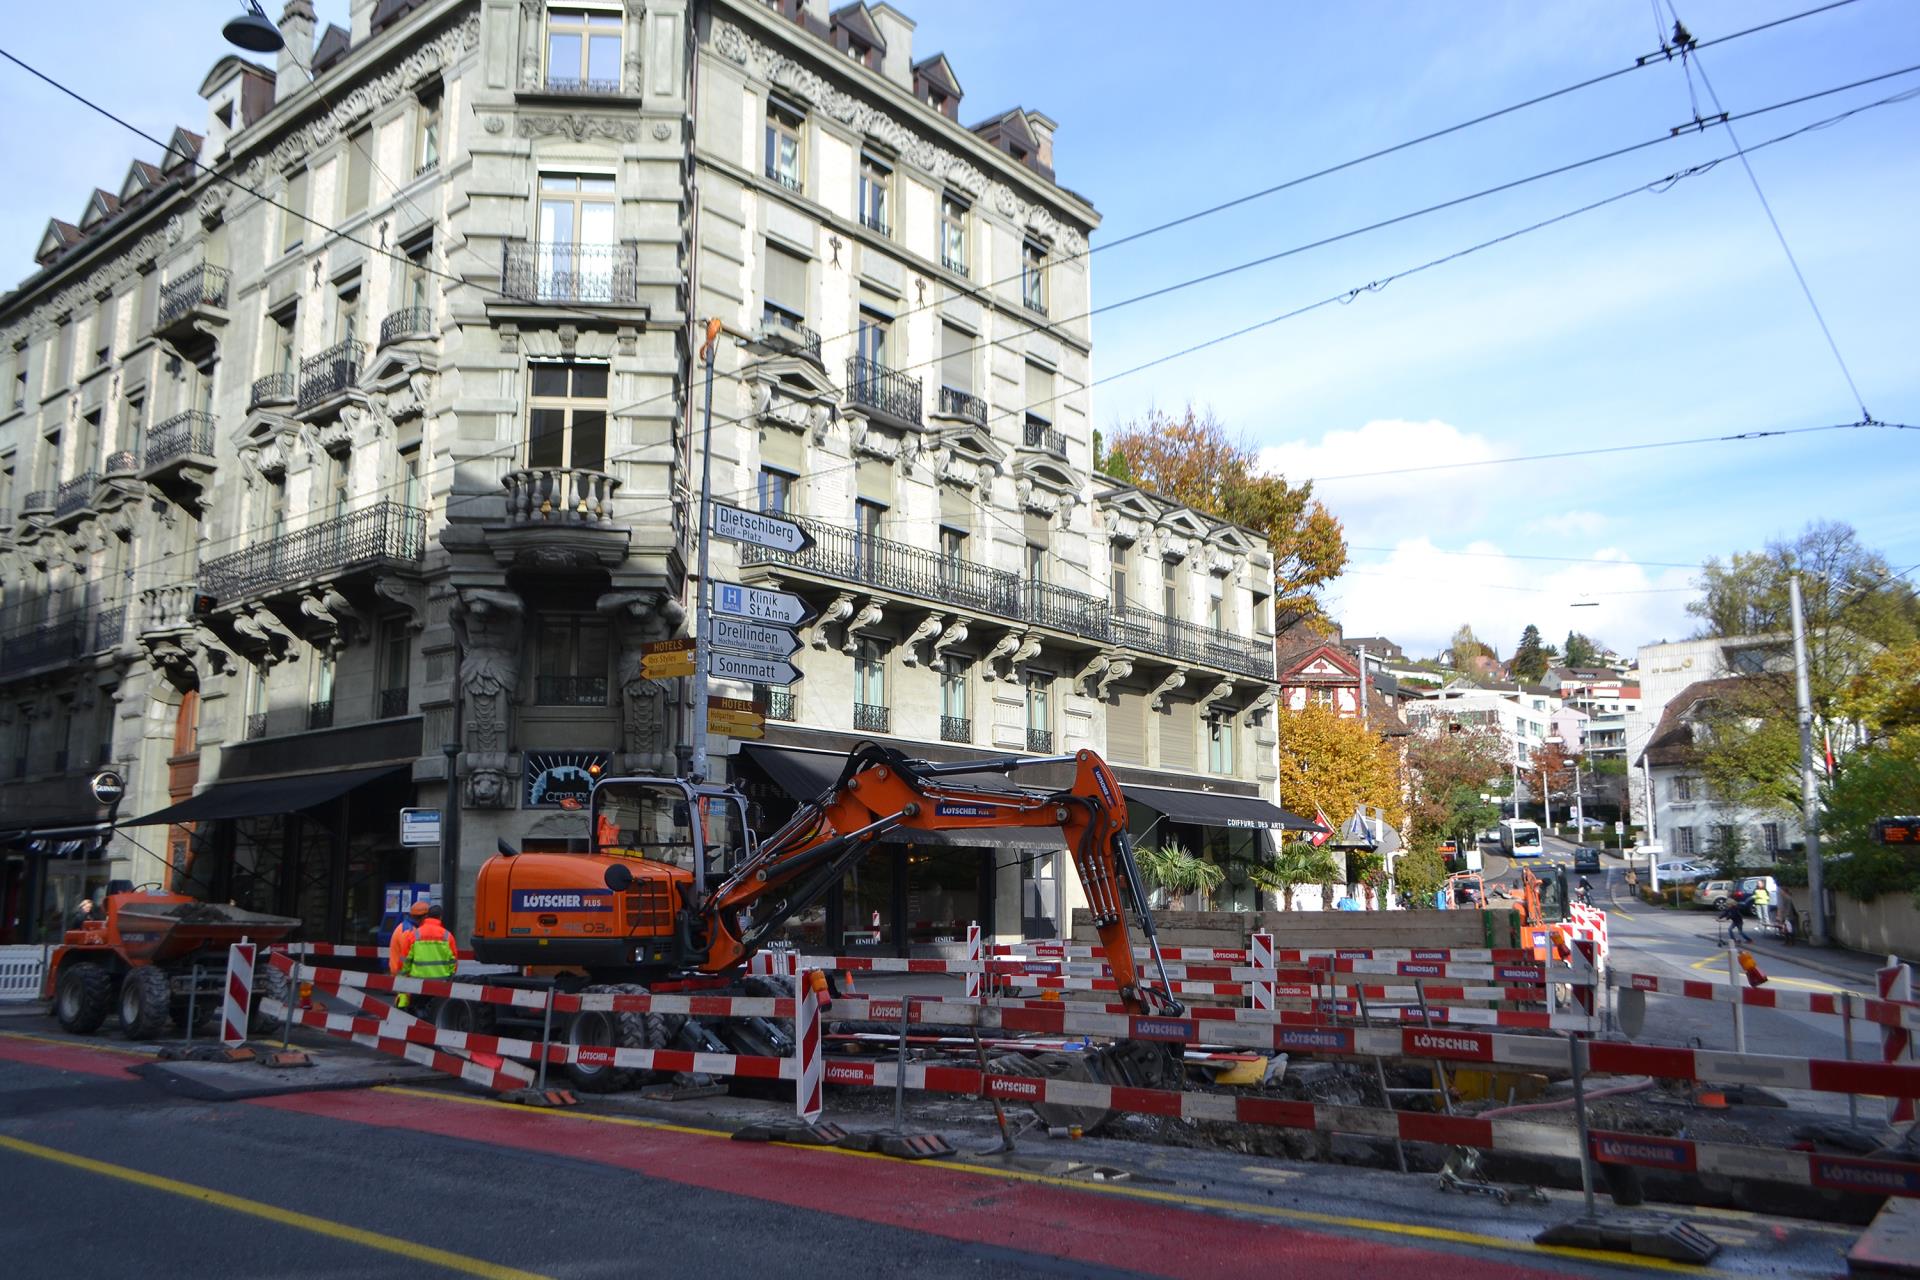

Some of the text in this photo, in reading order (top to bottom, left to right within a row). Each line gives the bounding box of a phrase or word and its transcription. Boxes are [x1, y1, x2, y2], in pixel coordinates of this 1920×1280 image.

[720, 524, 735, 535] Golf
[743, 529, 762, 542] Platz
[721, 508, 793, 542] Dietschiberg
[750, 590, 778, 606] Klinik
[719, 622, 778, 645] Dreilinden
[655, 640, 683, 652] HOTELS
[720, 657, 776, 679] Sonnmatt
[721, 698, 753, 711] HOTELS
[1227, 818, 1285, 830] COIFFURE DES ARTS
[523, 893, 601, 908] LÖTSCHER PLUS
[871, 1005, 903, 1018] LÖTSCHE
[1414, 1034, 1480, 1052] LÖTSCHER
[991, 1079, 1037, 1095] LÖTSCHER
